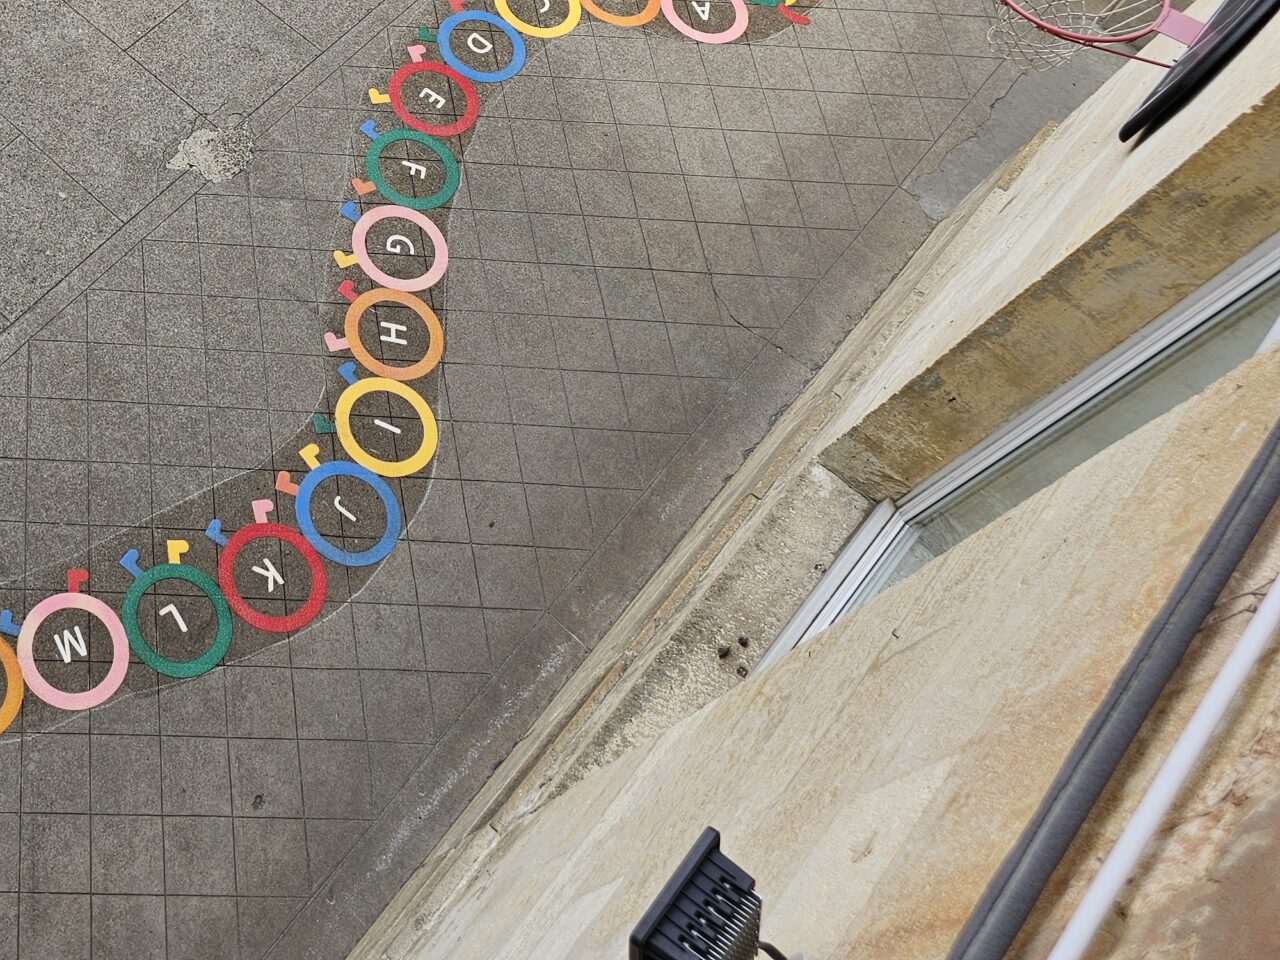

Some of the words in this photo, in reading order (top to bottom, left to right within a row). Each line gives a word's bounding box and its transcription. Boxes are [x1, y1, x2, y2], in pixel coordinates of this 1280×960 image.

[691, 1, 711, 21] A
[466, 32, 494, 54] D
[418, 87, 446, 109] E
[401, 160, 427, 180] F
[386, 234, 415, 255] G
[379, 321, 408, 346] H
[373, 418, 402, 435] I
[333, 495, 357, 522] J
[251, 557, 285, 593] K
[158, 603, 188, 633] L
[53, 625, 88, 664] M
